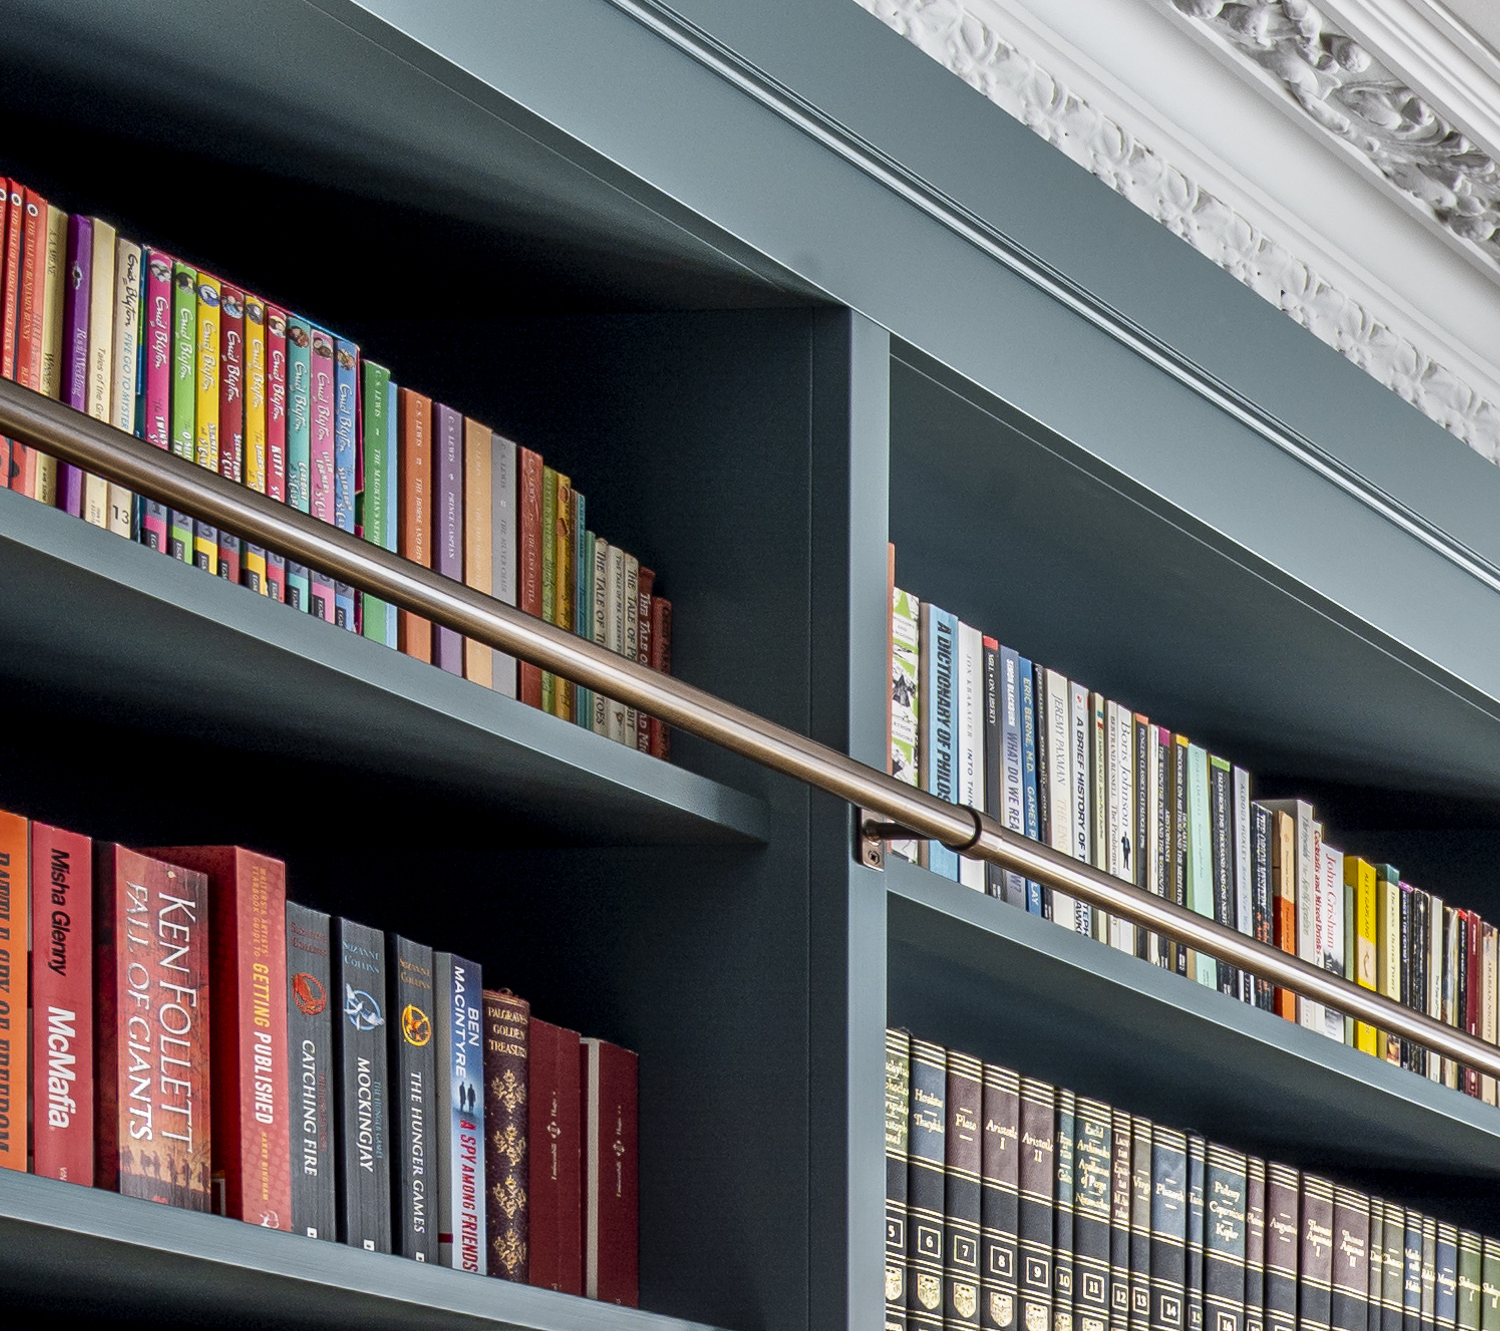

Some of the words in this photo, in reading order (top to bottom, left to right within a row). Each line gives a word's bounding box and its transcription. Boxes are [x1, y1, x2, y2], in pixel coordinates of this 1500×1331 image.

[154, 296, 168, 330] Enid
[153, 332, 170, 370] Blyton
[447, 491, 456, 522] PRINCE
[447, 523, 456, 559] CASPIAN
[1121, 721, 1131, 761] Boris
[1119, 763, 1132, 827] Johnson
[50, 848, 72, 905] Misha
[46, 910, 72, 977] Glenny
[126, 881, 149, 953] FALL
[158, 891, 196, 973] KEN
[127, 962, 150, 1007] OF
[47, 1006, 77, 1129] McMafia
[127, 1015, 152, 1140] GIANTS
[159, 982, 196, 1152] FOLLETT
[302, 1039, 318, 1134] CATCHING
[410, 1072, 425, 1103] THE
[355, 1057, 374, 1172] MOCKINGJAY
[302, 1139, 319, 1175] FIRE
[411, 1108, 426, 1177] HUNGER
[411, 1180, 427, 1233] GAMES
[960, 1242, 970, 1258] 7
[996, 1254, 1007, 1270] 8
